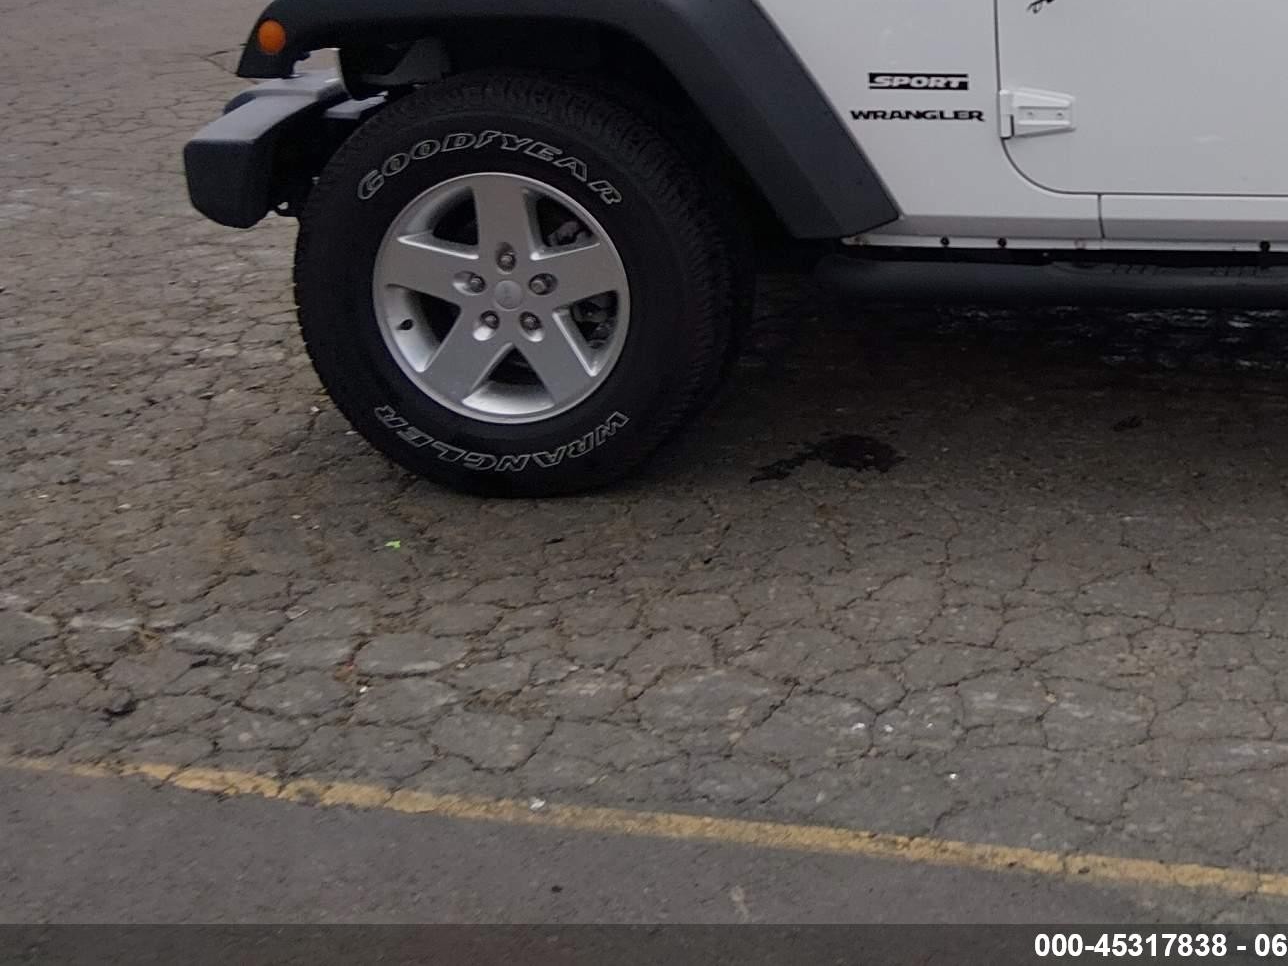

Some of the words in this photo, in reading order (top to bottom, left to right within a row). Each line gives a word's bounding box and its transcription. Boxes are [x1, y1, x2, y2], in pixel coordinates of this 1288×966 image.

[868, 73, 968, 90] SPORT
[850, 110, 985, 121] WRANGLER
[357, 130, 622, 204] GOODYEAR
[374, 405, 630, 472] WRANGLER
